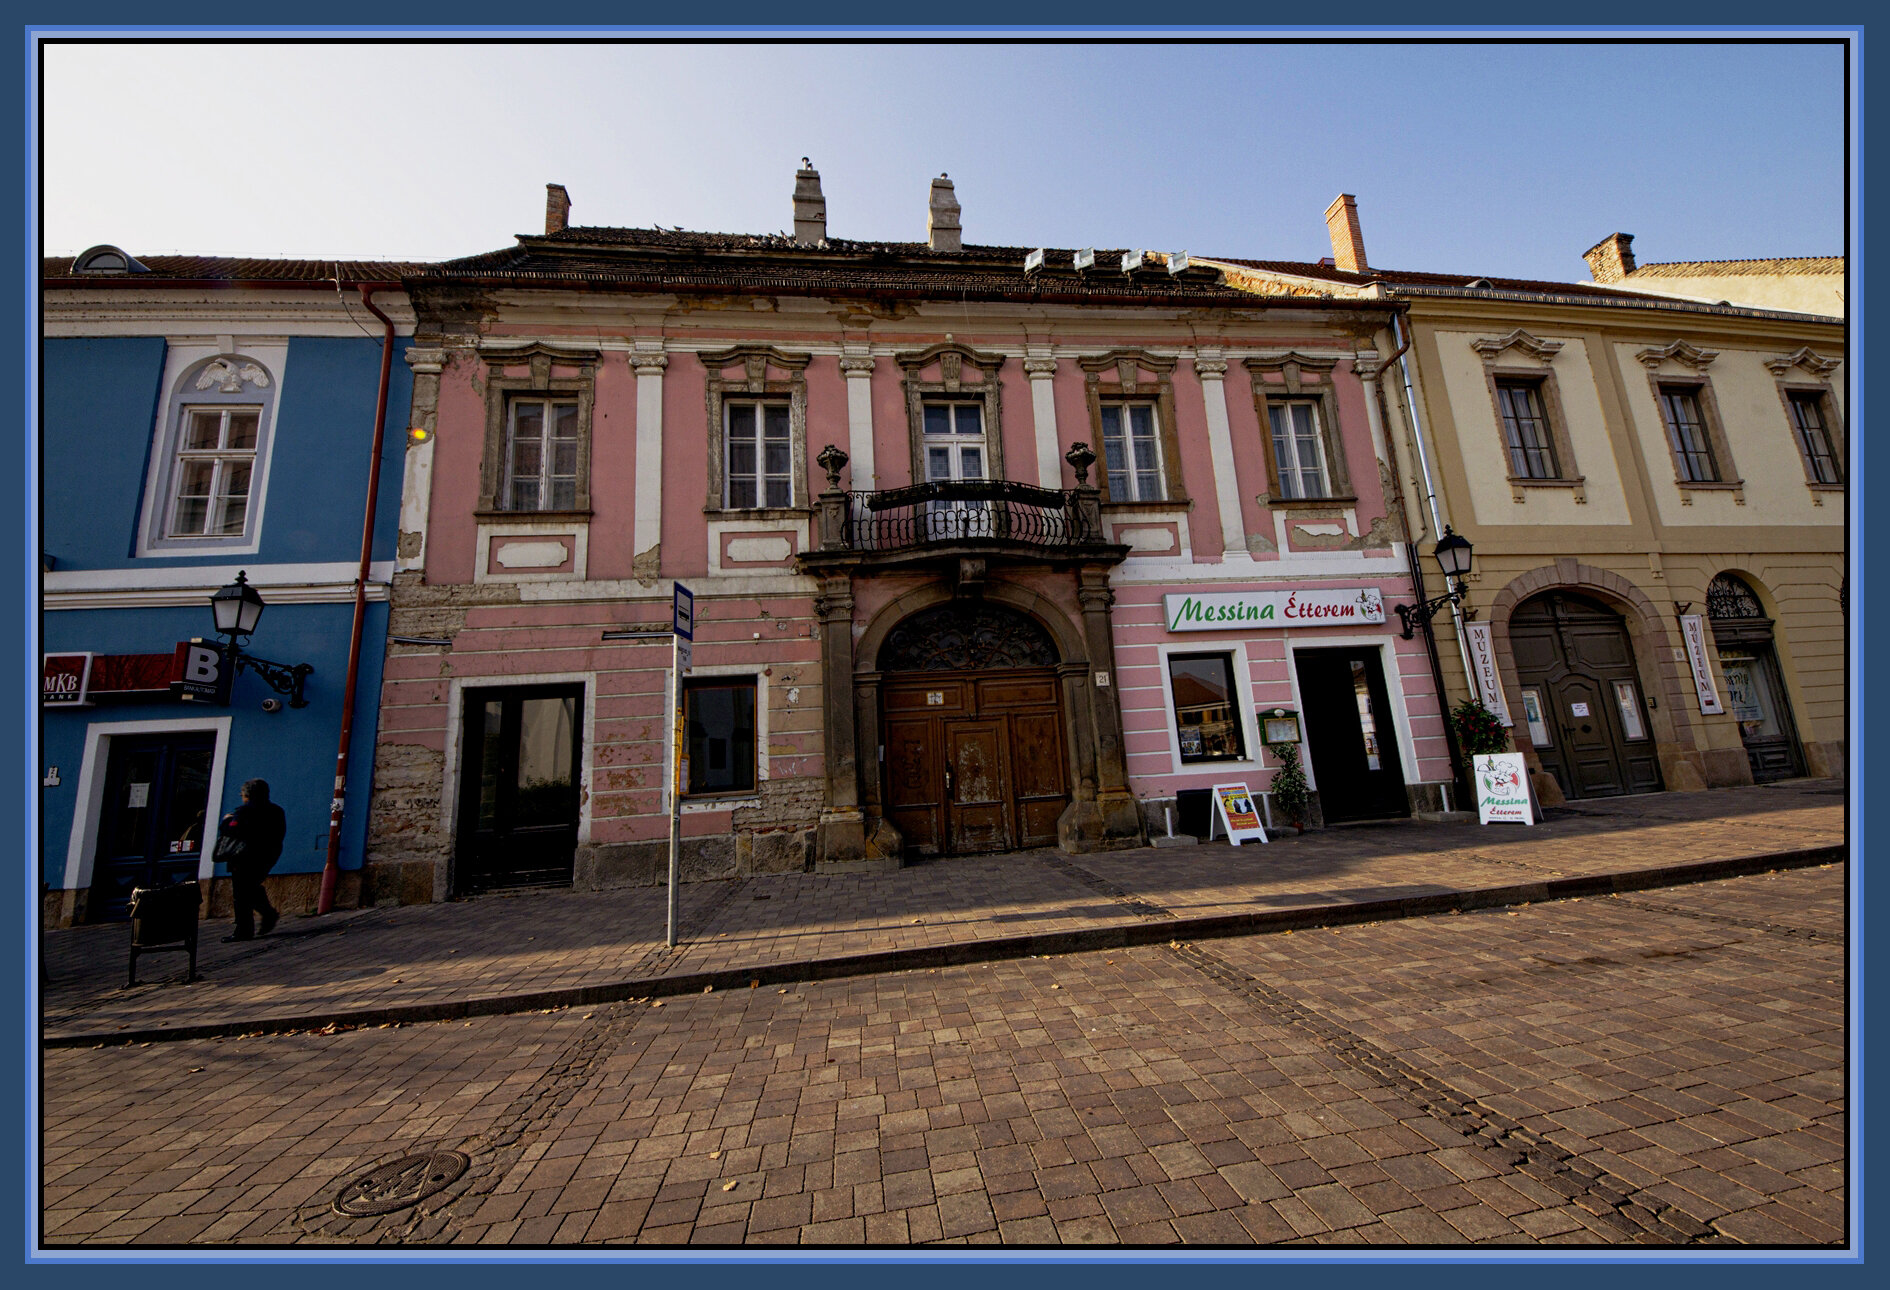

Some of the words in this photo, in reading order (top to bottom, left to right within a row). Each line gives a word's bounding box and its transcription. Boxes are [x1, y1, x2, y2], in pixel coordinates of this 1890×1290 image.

[1171, 596, 1275, 629] Messina
[1284, 591, 1355, 619] Étterem
[185, 645, 220, 683] B
[1473, 628, 1499, 703] MÚZEUM
[44, 673, 78, 693] MKB
[1098, 675, 1107, 683] 21
[1480, 796, 1528, 807] Messina
